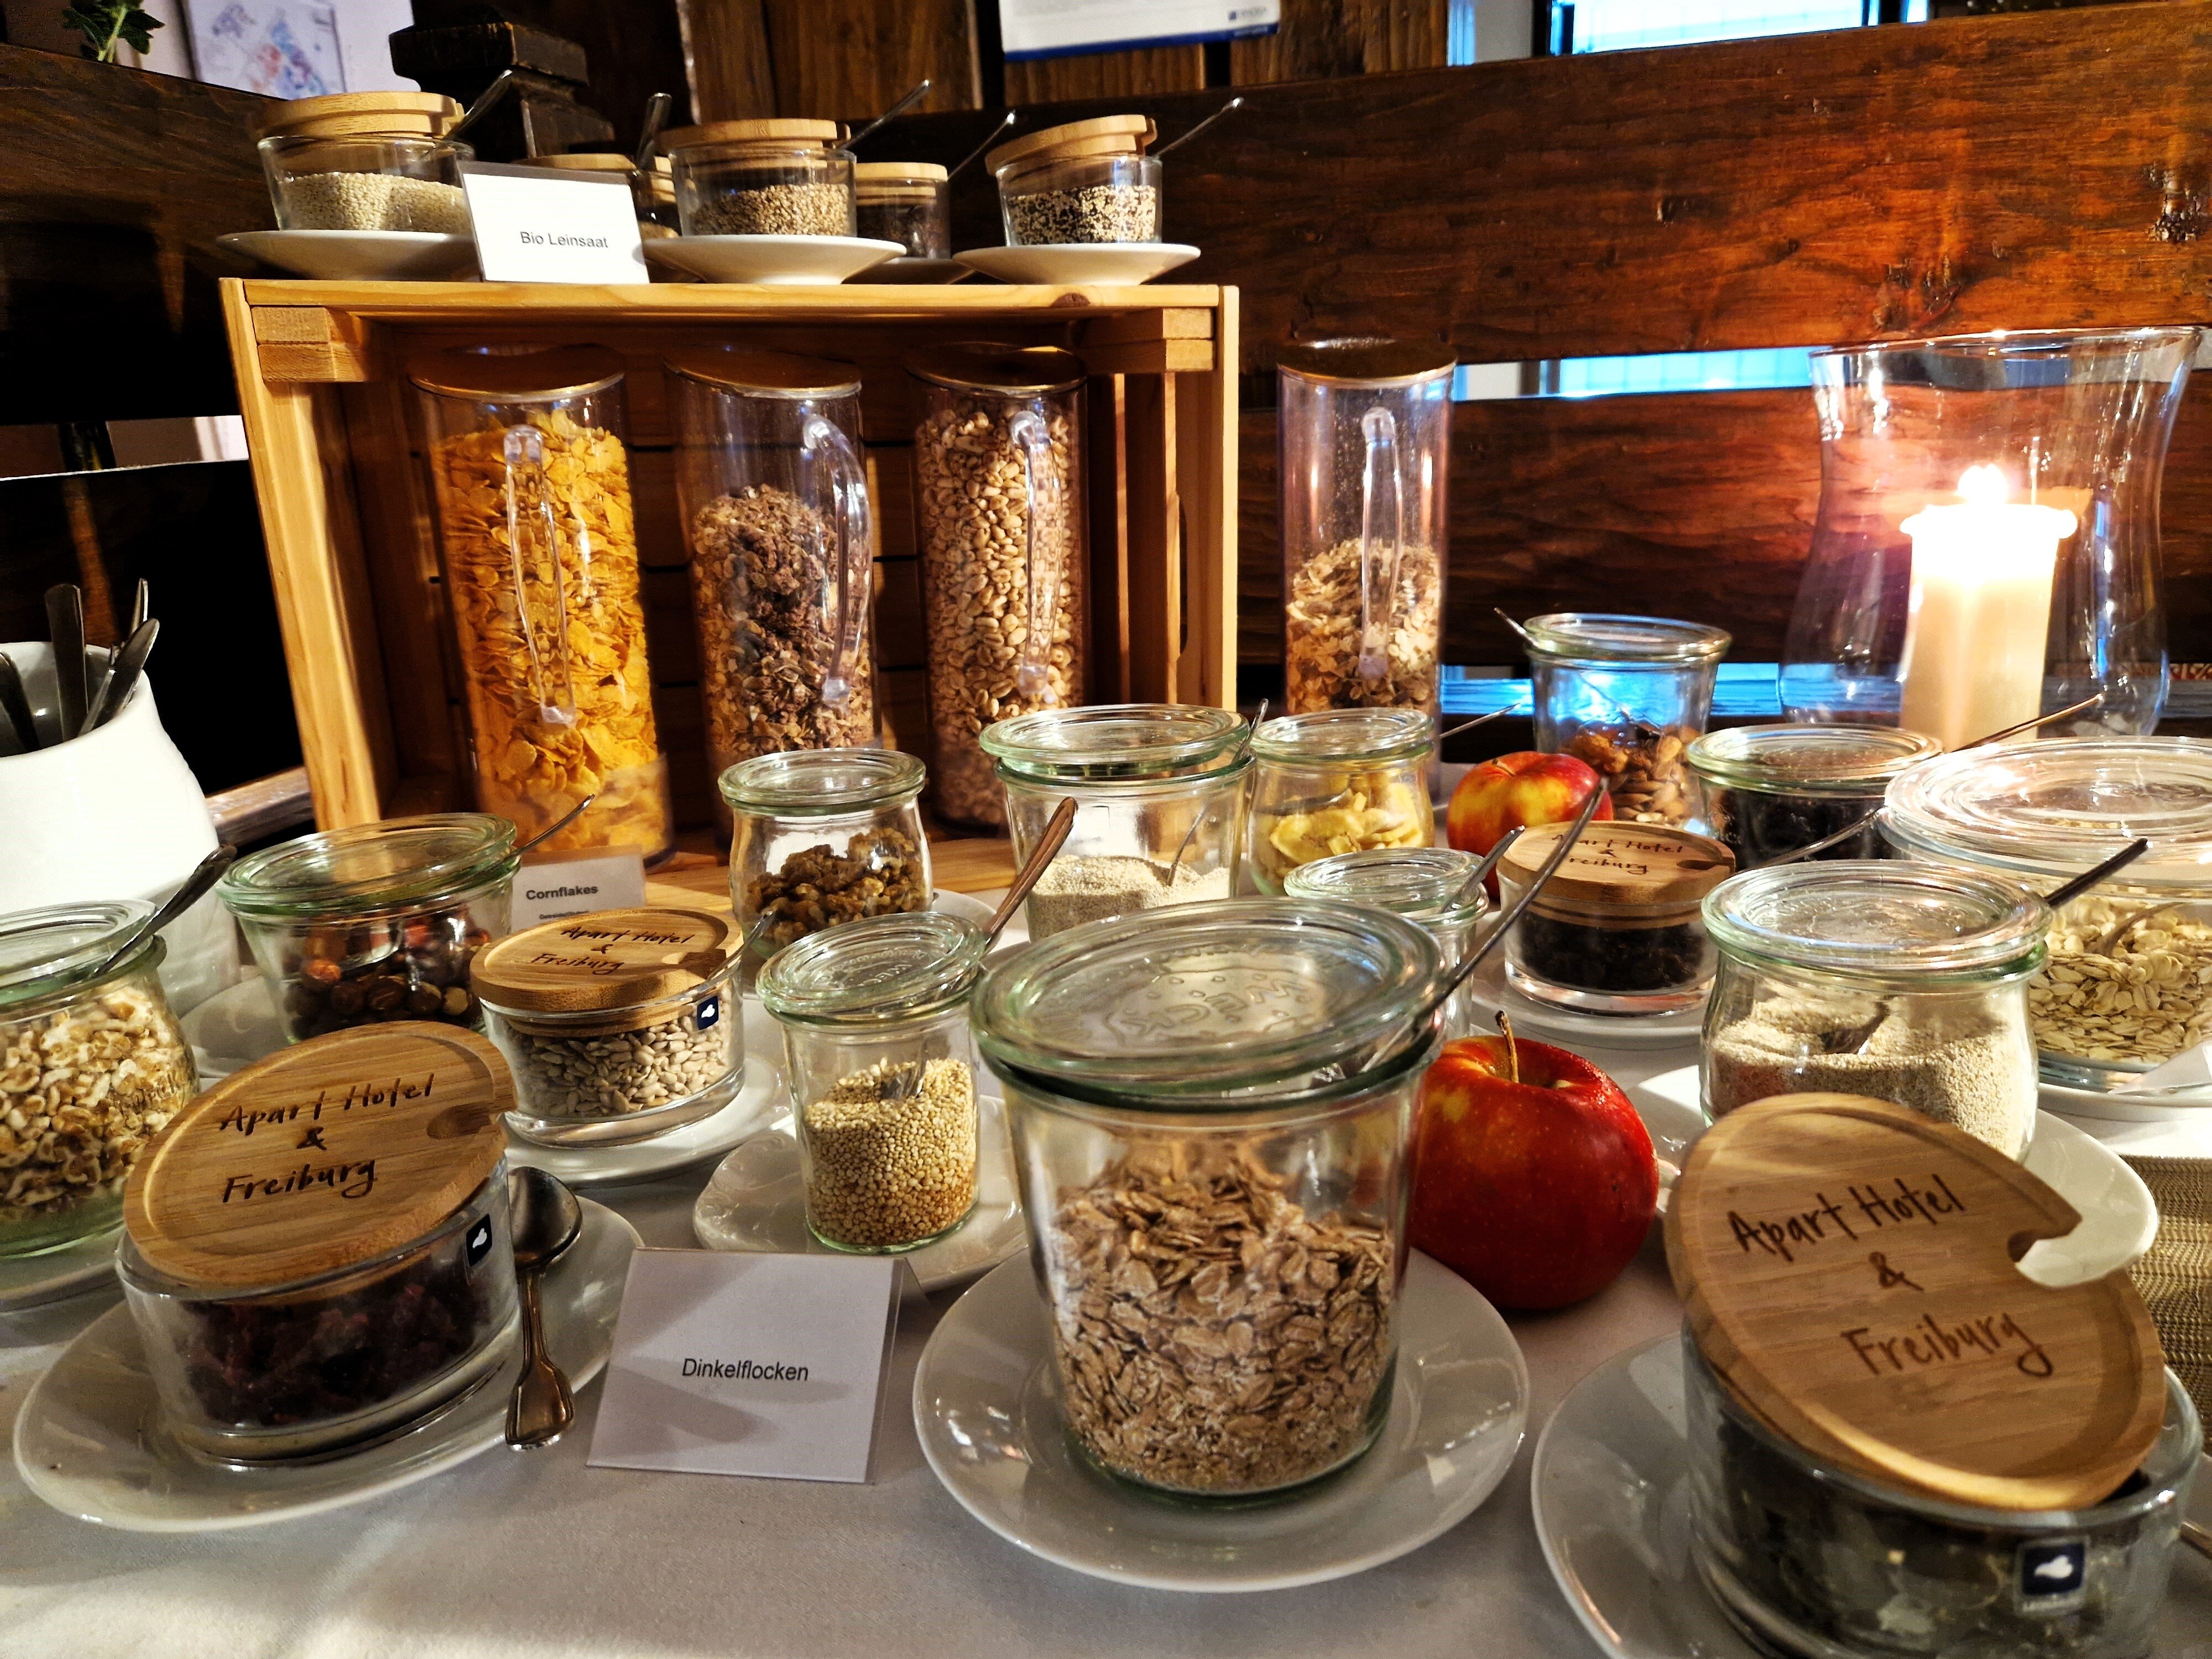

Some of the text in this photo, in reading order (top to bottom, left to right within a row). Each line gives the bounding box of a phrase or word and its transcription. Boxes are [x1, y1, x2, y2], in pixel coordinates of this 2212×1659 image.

[520, 231, 609, 248] Bio Leinsaat
[1552, 834, 1683, 853] Aart Hotel
[1597, 849, 1617, 858] &
[1567, 855, 1649, 875] reiburg
[526, 886, 598, 900] Cornflakes
[561, 926, 695, 944] Apart Hotel
[531, 953, 624, 975] Freiburg
[220, 1091, 326, 1136] Apart
[344, 1073, 434, 1110] Hotel
[297, 1127, 326, 1150] &
[222, 1160, 378, 1203] Freiburg
[1728, 1173, 1964, 1261] Apart Hotel
[1869, 1251, 1923, 1291] &
[1840, 1312, 2053, 1376] Freiburg
[682, 1358, 809, 1381] Dinkelflocken
